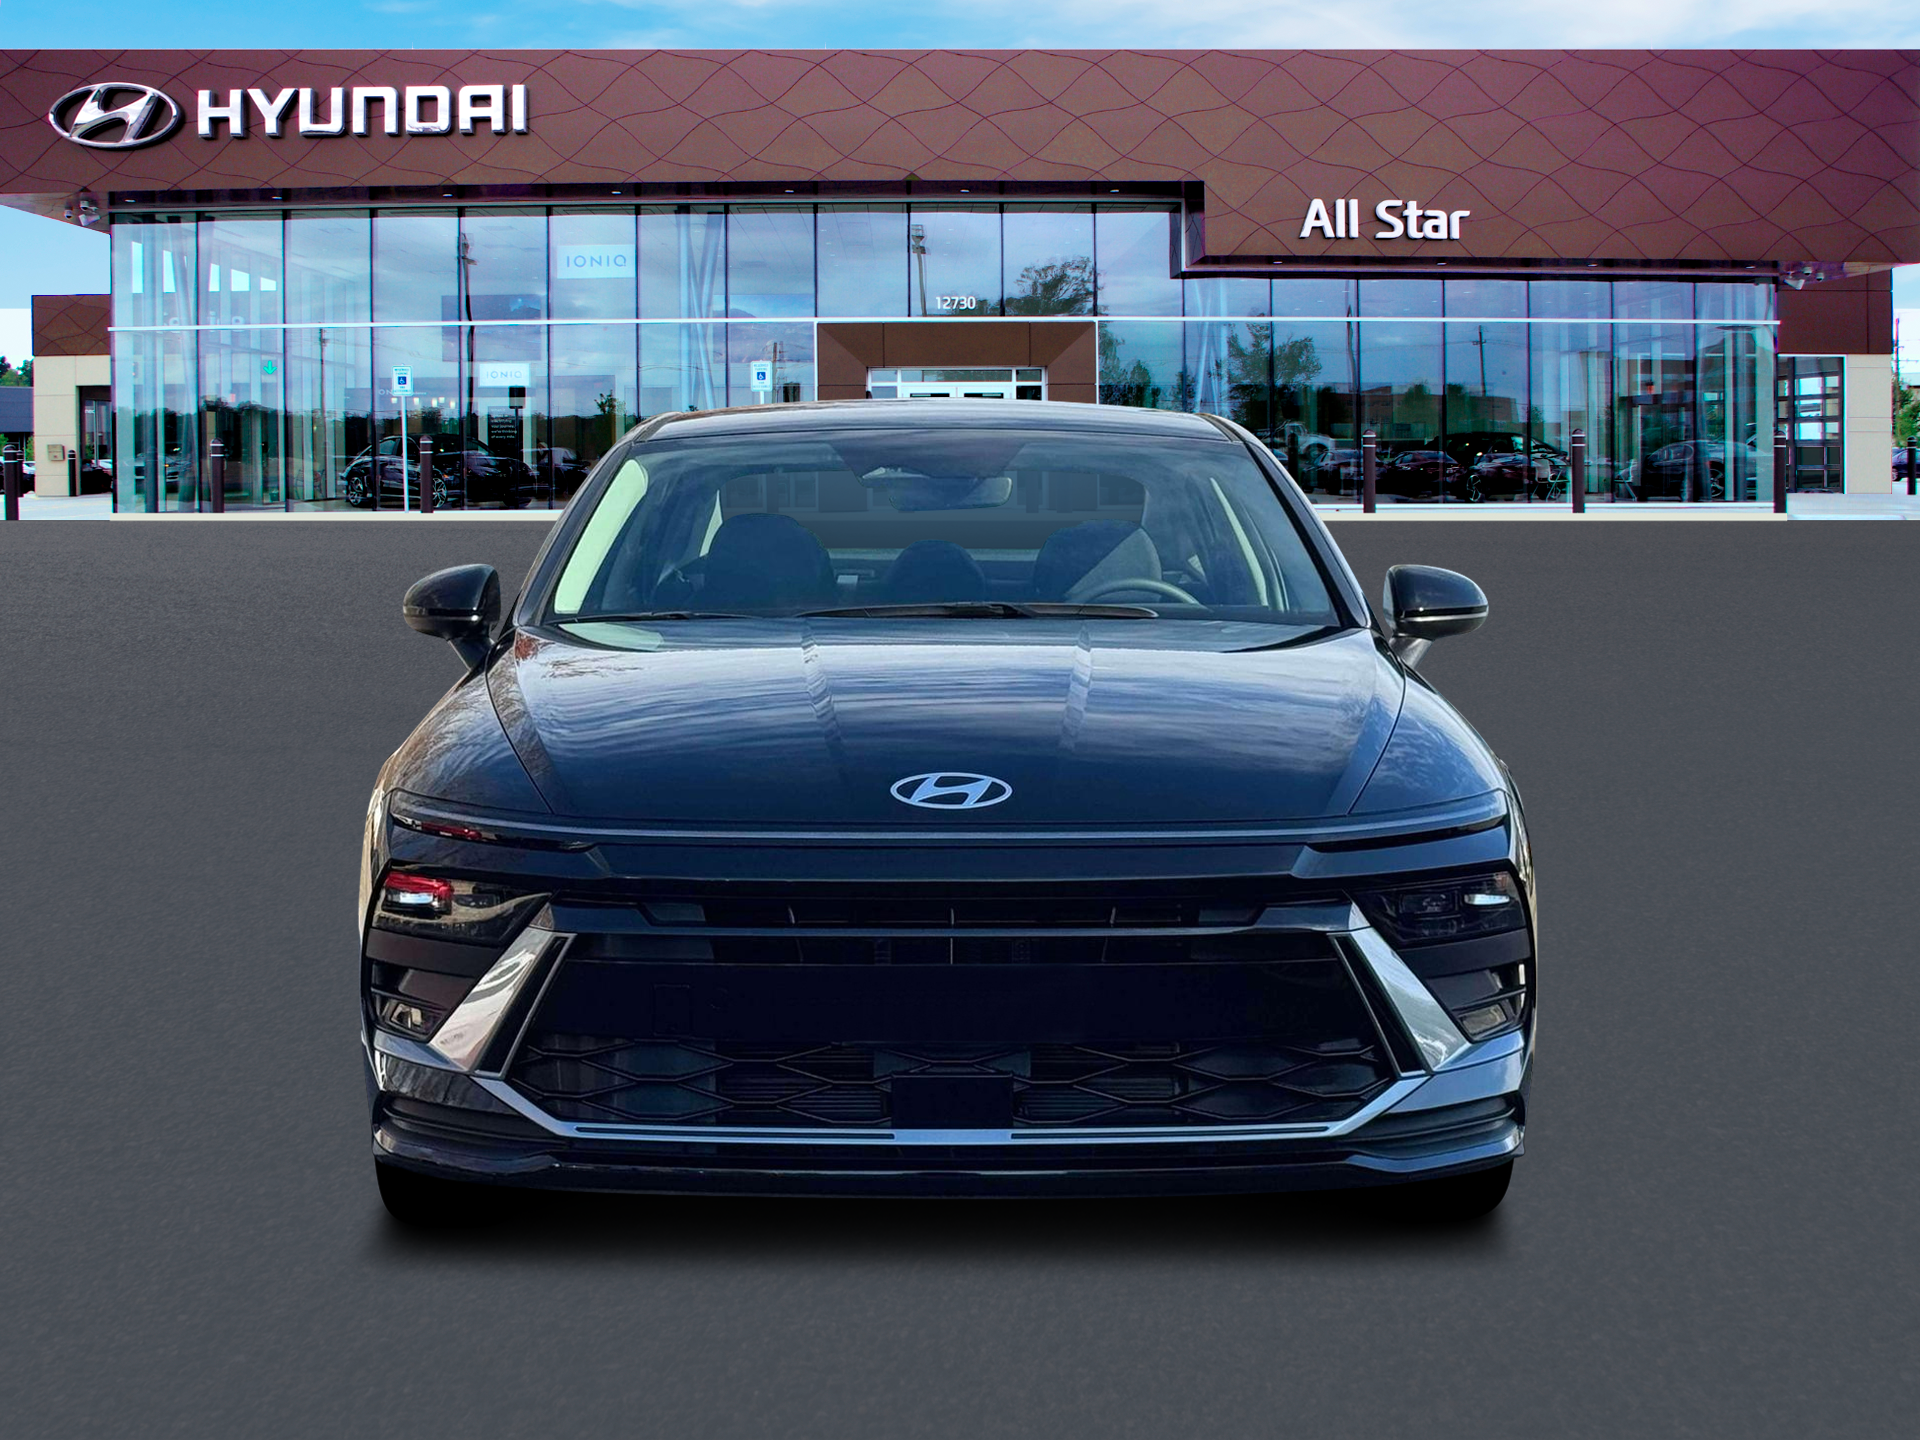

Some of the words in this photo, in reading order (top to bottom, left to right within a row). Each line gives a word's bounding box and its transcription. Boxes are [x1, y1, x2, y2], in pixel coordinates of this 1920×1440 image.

[197, 84, 529, 138] HYUNDAI
[1299, 198, 1359, 239] All
[1374, 199, 1471, 240] Star
[566, 254, 627, 268] IONIQ
[935, 296, 976, 310] 12730
[486, 370, 523, 379] IONIQ
